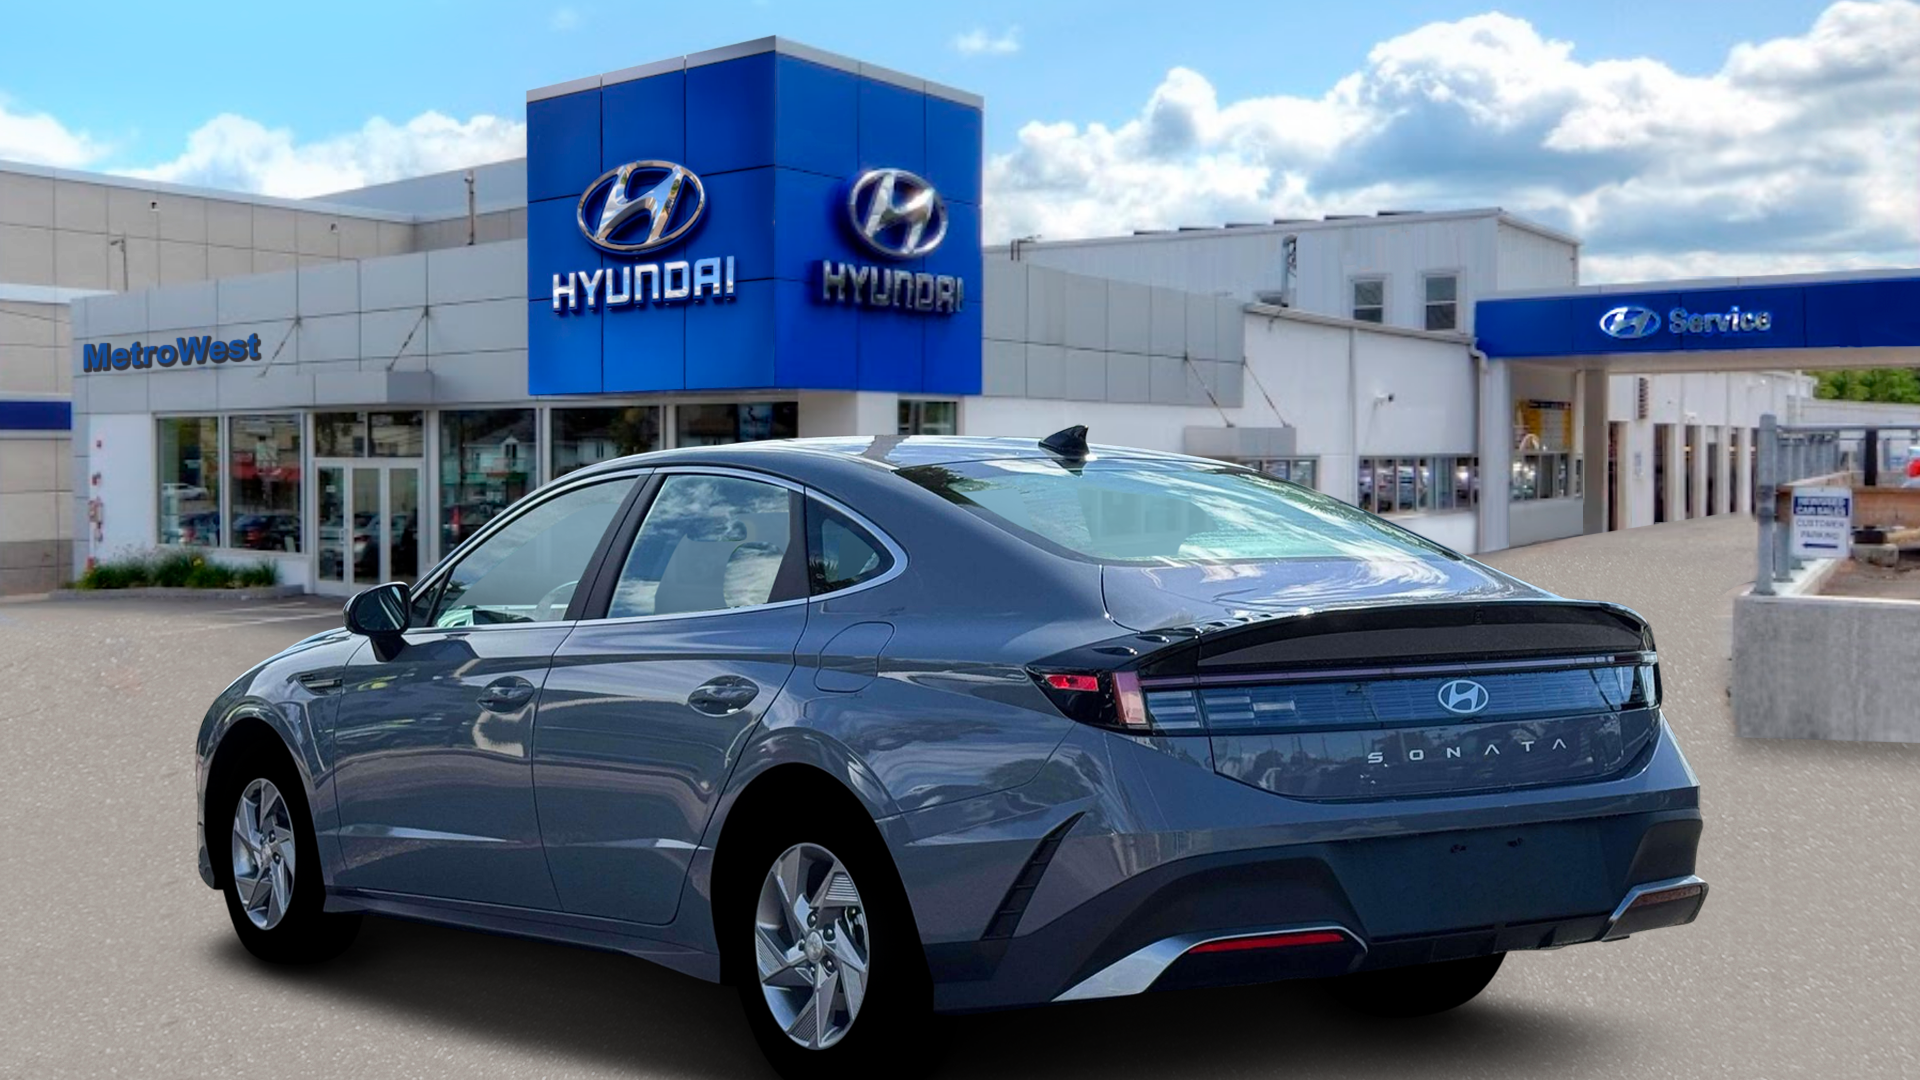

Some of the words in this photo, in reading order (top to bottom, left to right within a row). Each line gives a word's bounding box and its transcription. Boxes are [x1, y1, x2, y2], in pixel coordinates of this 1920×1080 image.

[552, 256, 735, 312] HYUNDAI
[822, 260, 964, 313] HYUNDAI
[1669, 306, 1772, 334] Service
[83, 333, 262, 373] MetroWest
[1368, 739, 1566, 764] SONATA
